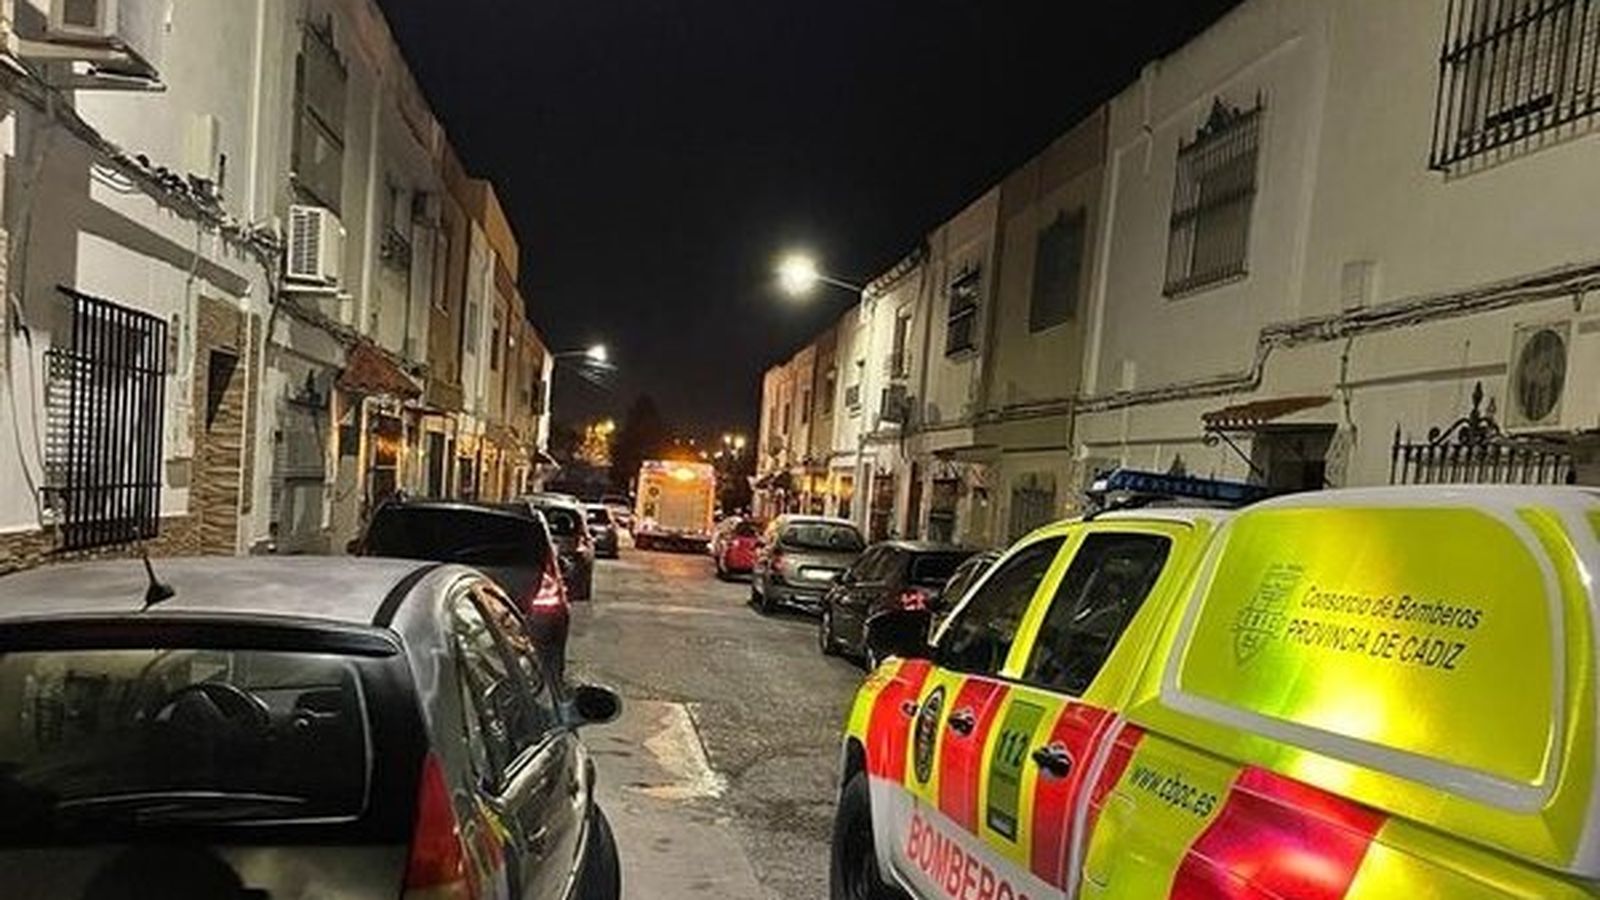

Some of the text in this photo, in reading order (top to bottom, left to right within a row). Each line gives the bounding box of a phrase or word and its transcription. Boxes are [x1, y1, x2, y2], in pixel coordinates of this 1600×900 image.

[1301, 585, 1483, 630] Consorcio de Bomberos
[1285, 619, 1370, 652] PROVINCIA
[1370, 631, 1401, 659] DE
[1400, 633, 1466, 670] CÁDIZ
[997, 728, 1028, 767] 112
[907, 813, 1031, 900] BOMBER
